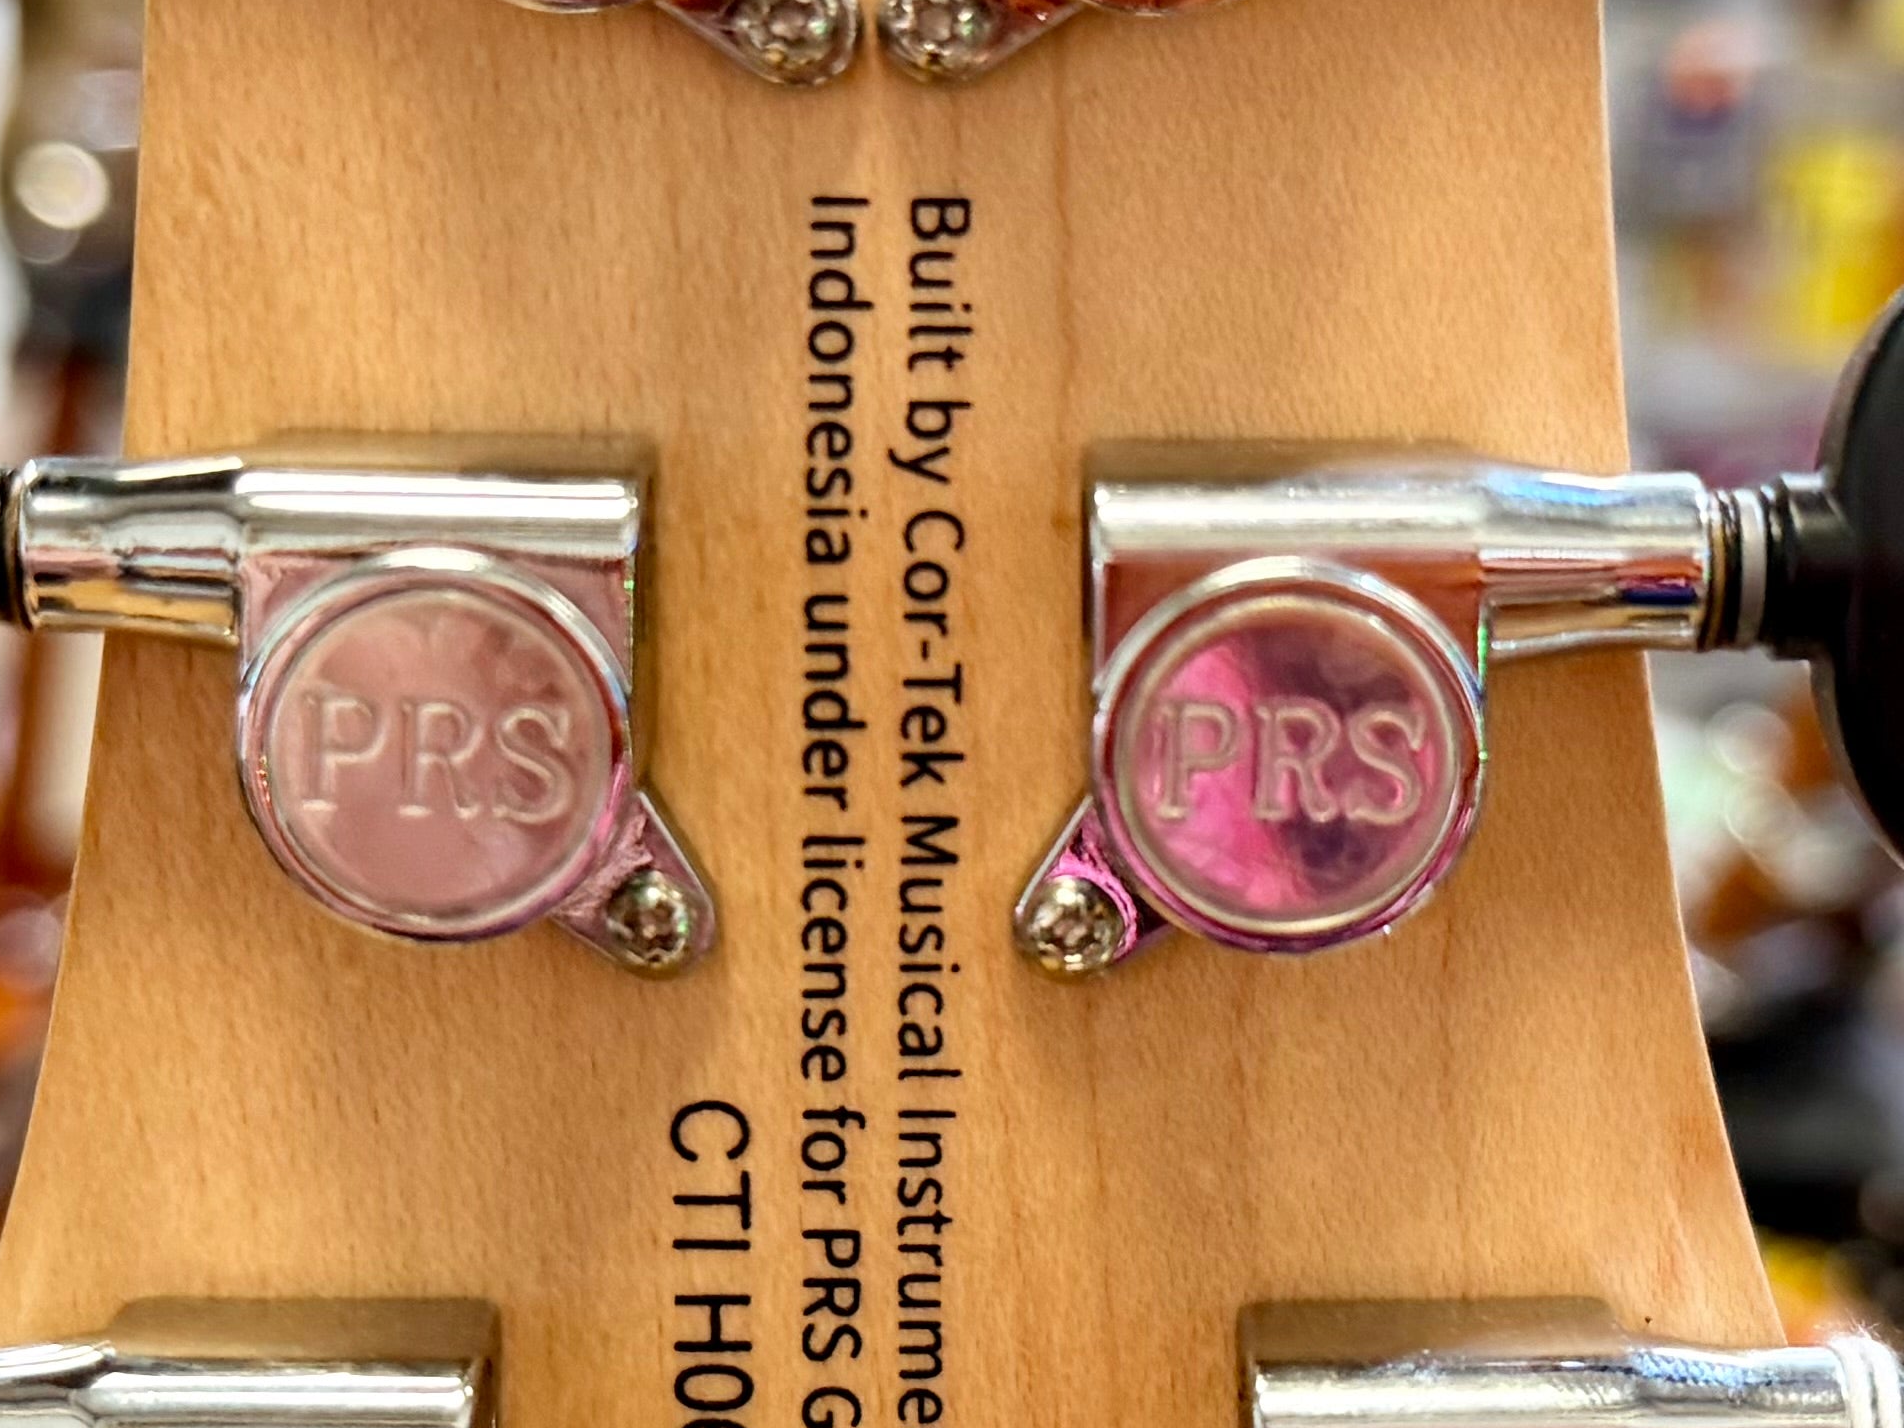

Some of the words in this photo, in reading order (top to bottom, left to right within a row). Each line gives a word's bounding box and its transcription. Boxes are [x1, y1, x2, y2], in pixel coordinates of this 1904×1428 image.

[906, 196, 975, 373] Built
[803, 194, 875, 567] Indonesia
[886, 399, 973, 486] by
[800, 592, 869, 813] under
[898, 508, 967, 790] Cor-Tek
[300, 686, 578, 826] PRS
[1148, 700, 1428, 826] PRS
[798, 833, 867, 1084] license
[896, 813, 964, 1082] Musical
[668, 1098, 753, 1253] CTI
[799, 1104, 868, 1207] for
[800, 1227, 864, 1364] PRS
